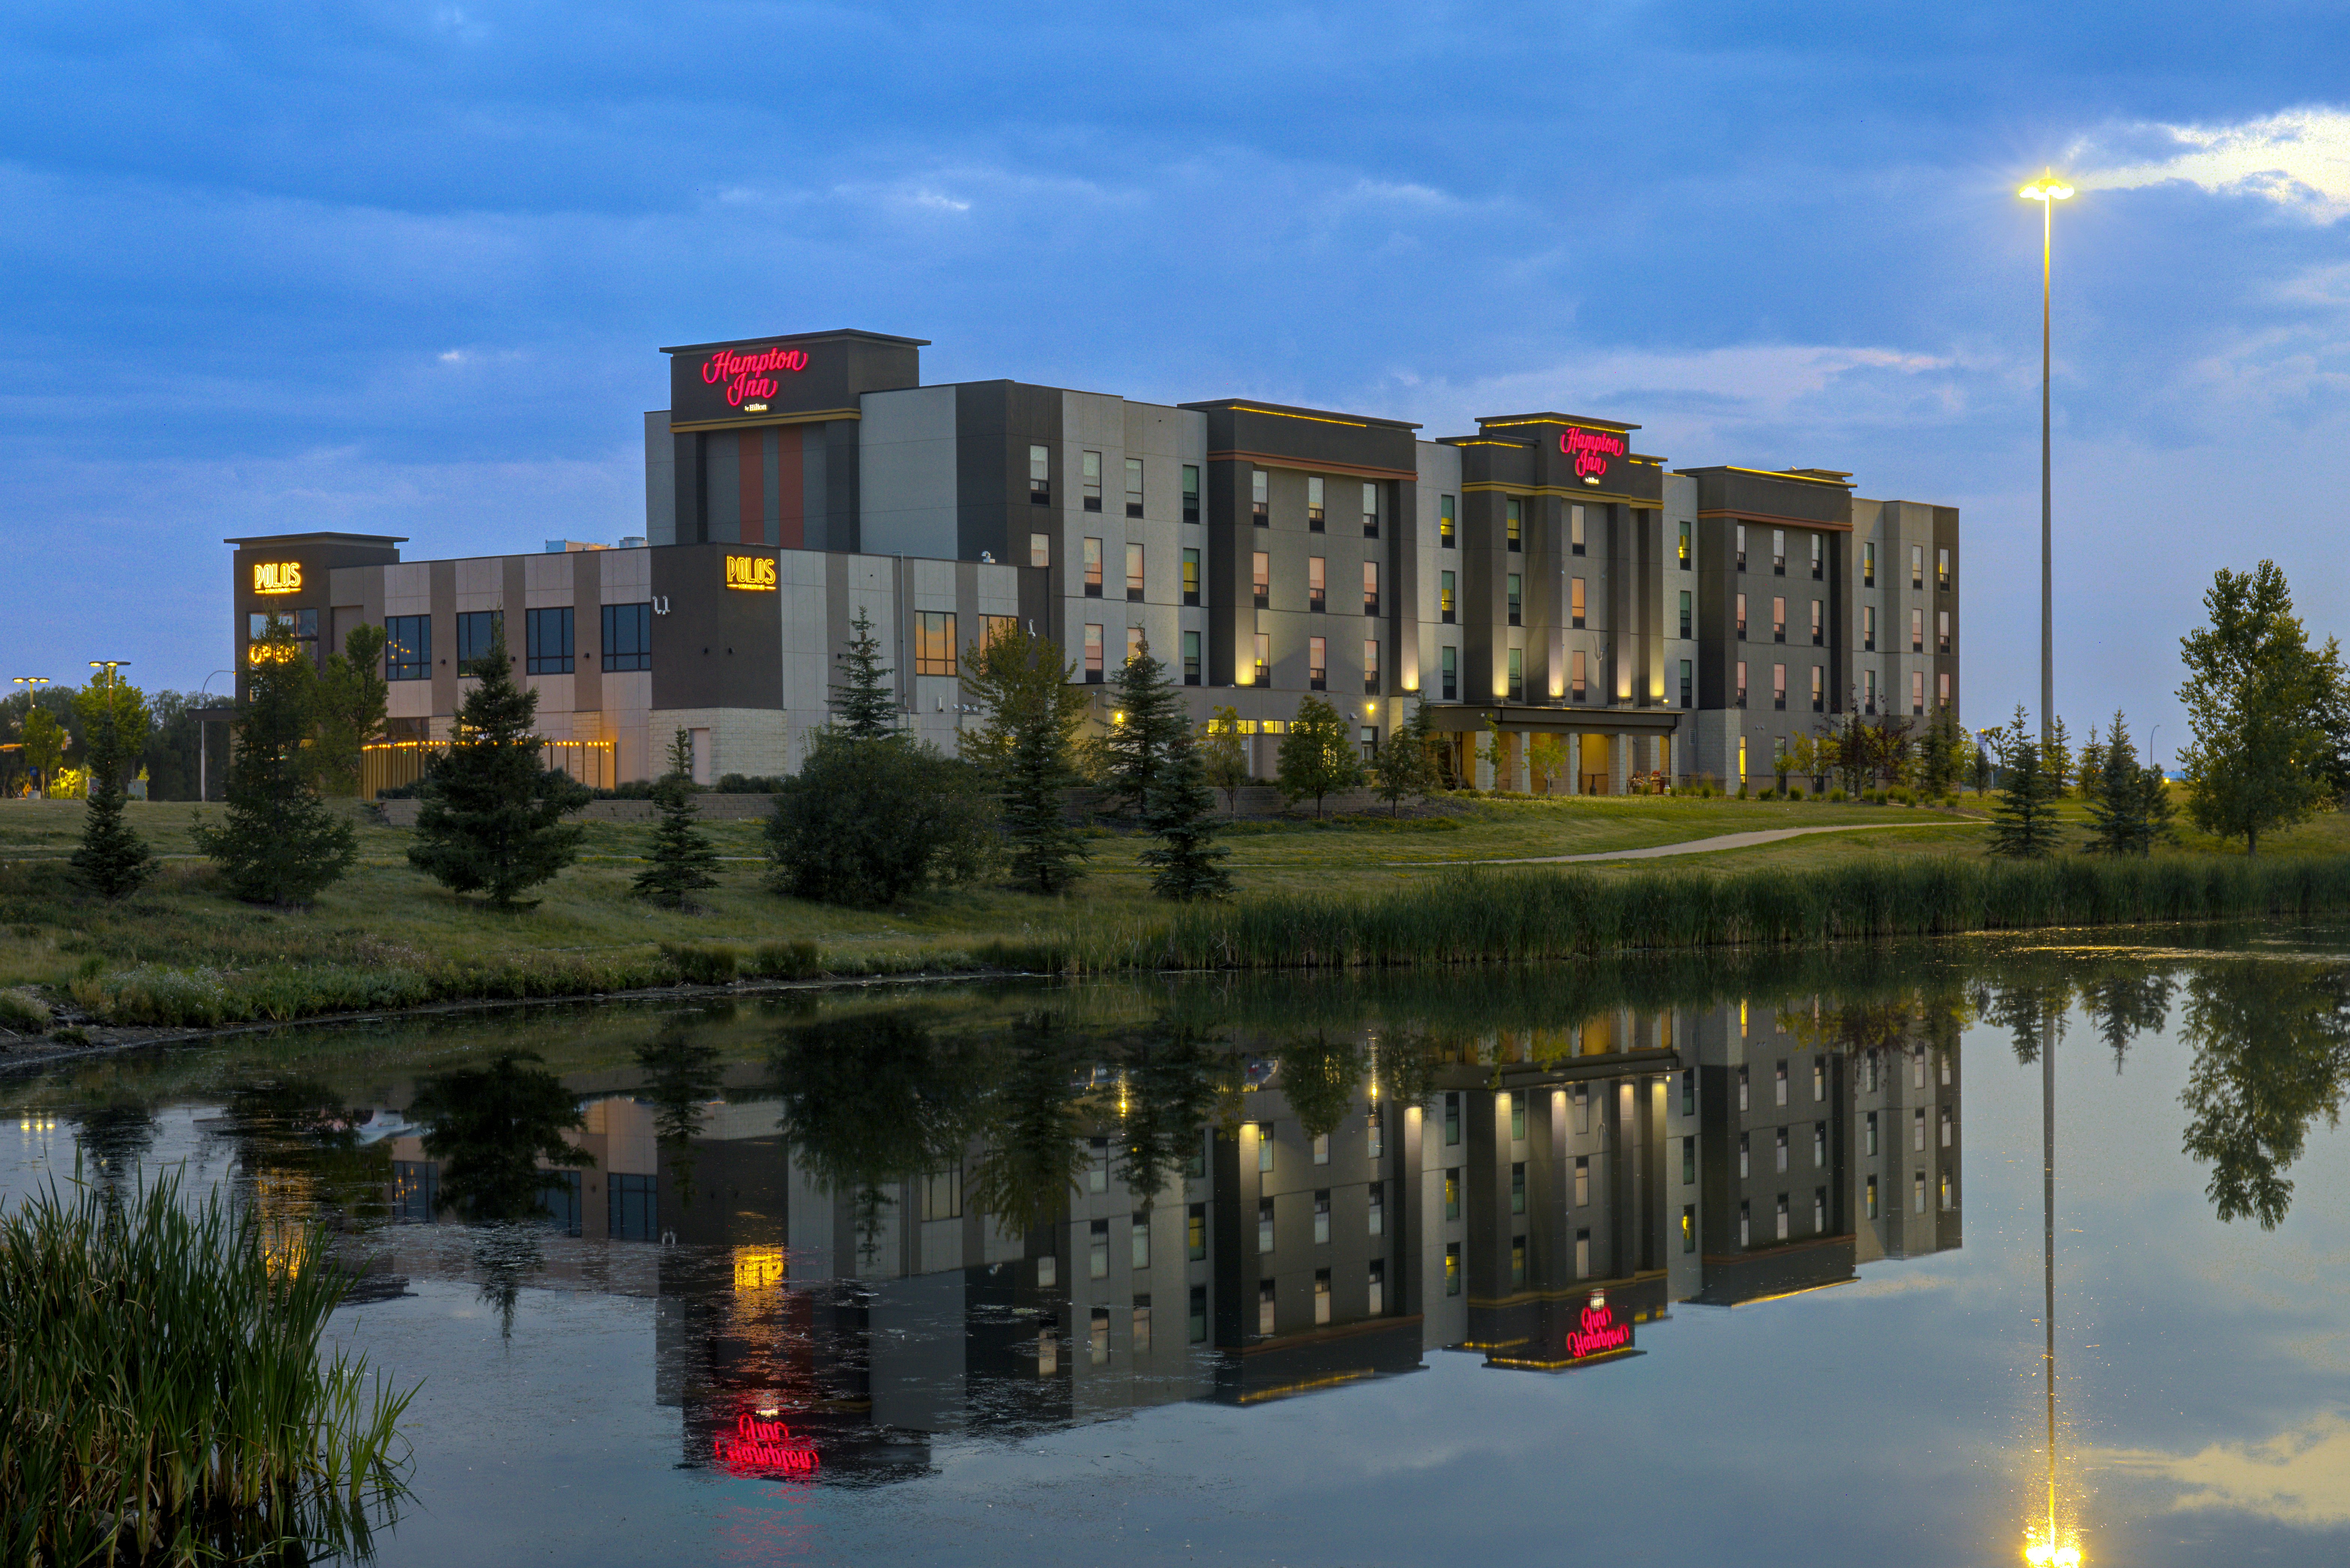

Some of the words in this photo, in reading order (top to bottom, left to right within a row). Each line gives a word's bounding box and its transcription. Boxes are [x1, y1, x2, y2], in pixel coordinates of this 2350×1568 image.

[703, 347, 808, 383] Hampton
[727, 372, 778, 406] Inn
[1560, 427, 1624, 457] Hampton
[1576, 448, 1607, 477] Inn
[254, 562, 301, 589] POLOS
[726, 556, 776, 584] POLOS
